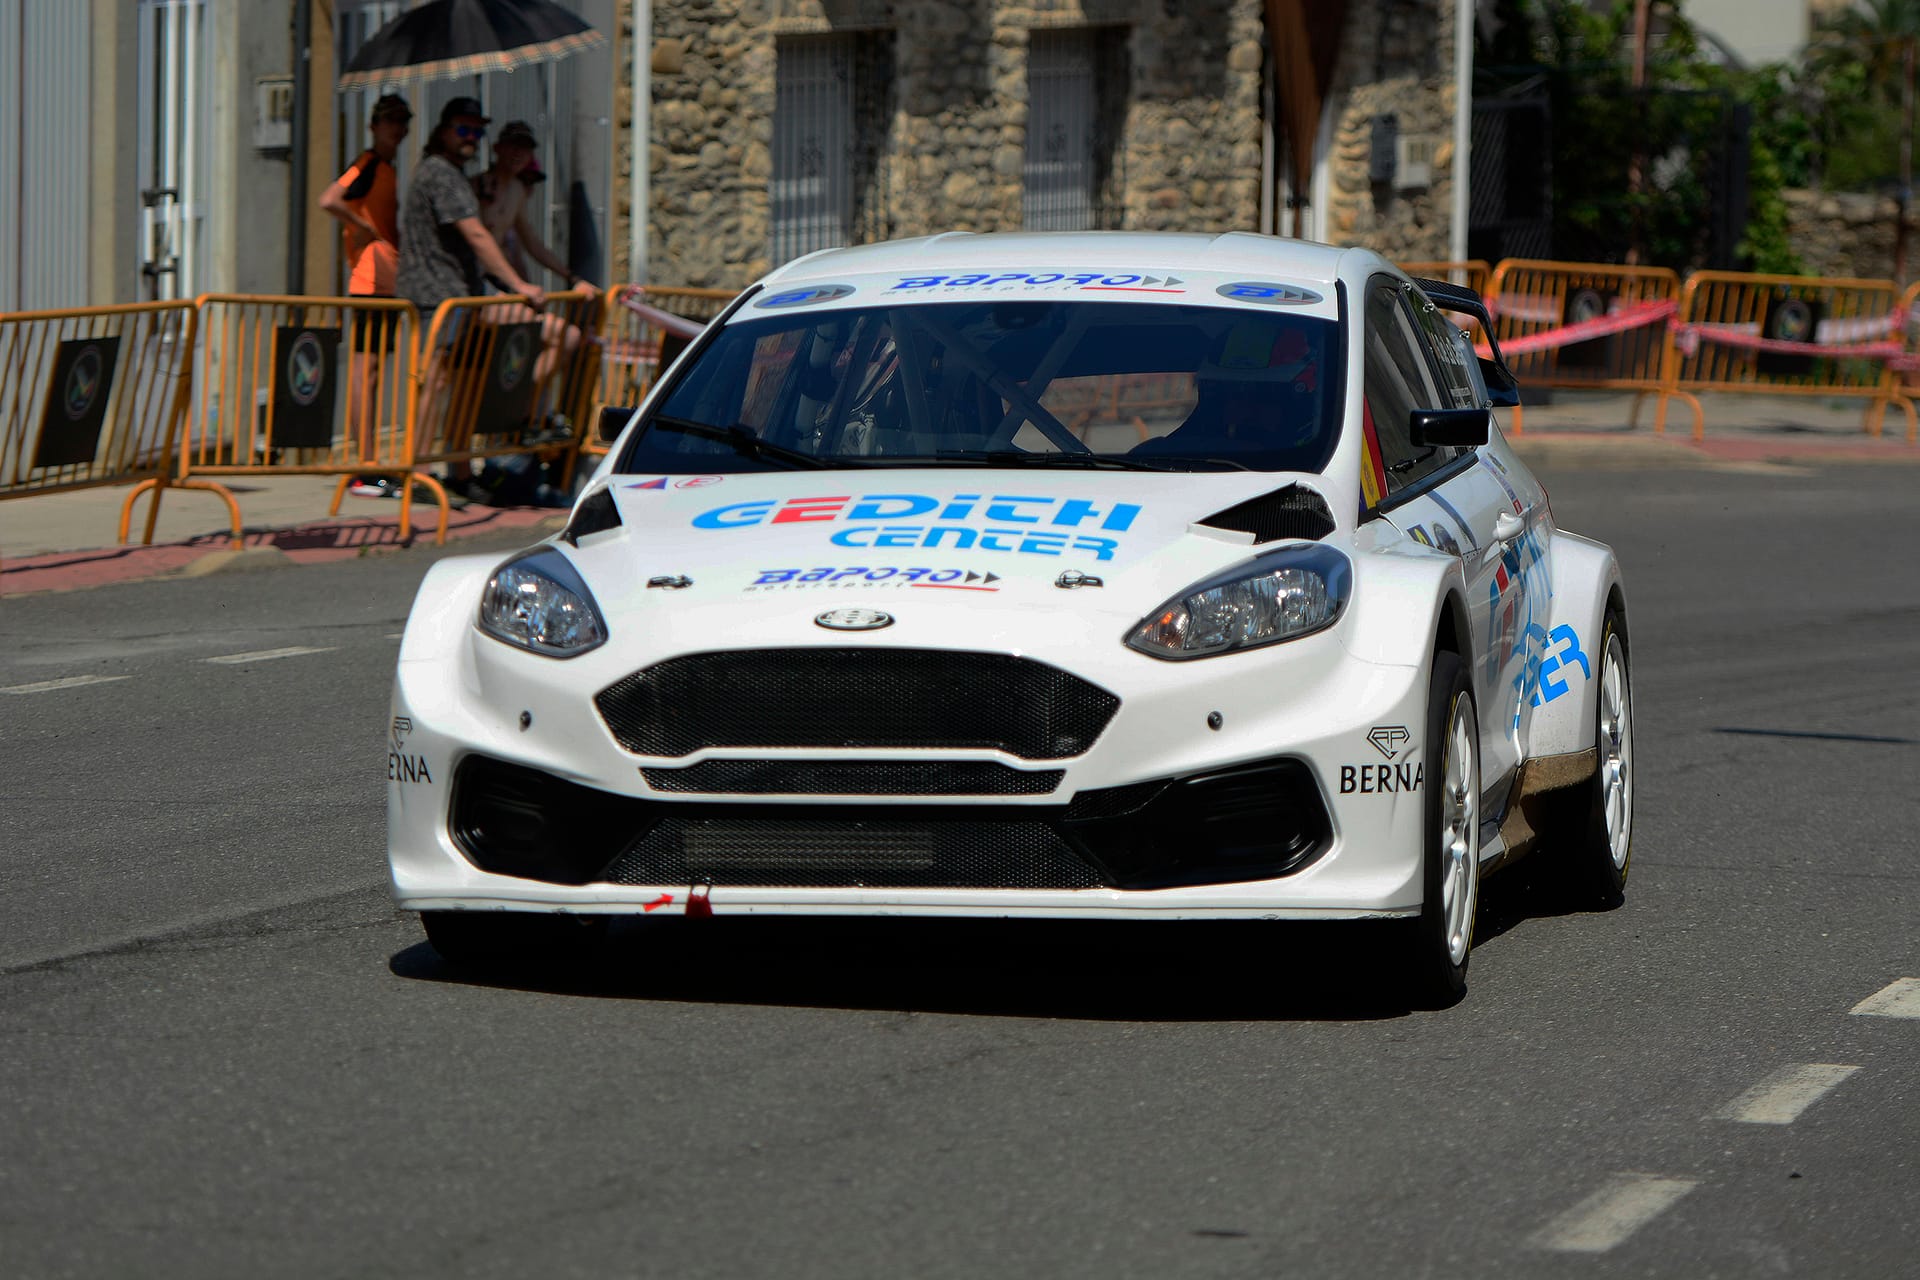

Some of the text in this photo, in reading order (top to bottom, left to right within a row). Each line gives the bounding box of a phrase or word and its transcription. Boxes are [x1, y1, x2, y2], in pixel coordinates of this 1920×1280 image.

[830, 526, 1119, 562] CENTER
[388, 753, 432, 784] ERNA
[1340, 761, 1425, 793] BERNA
